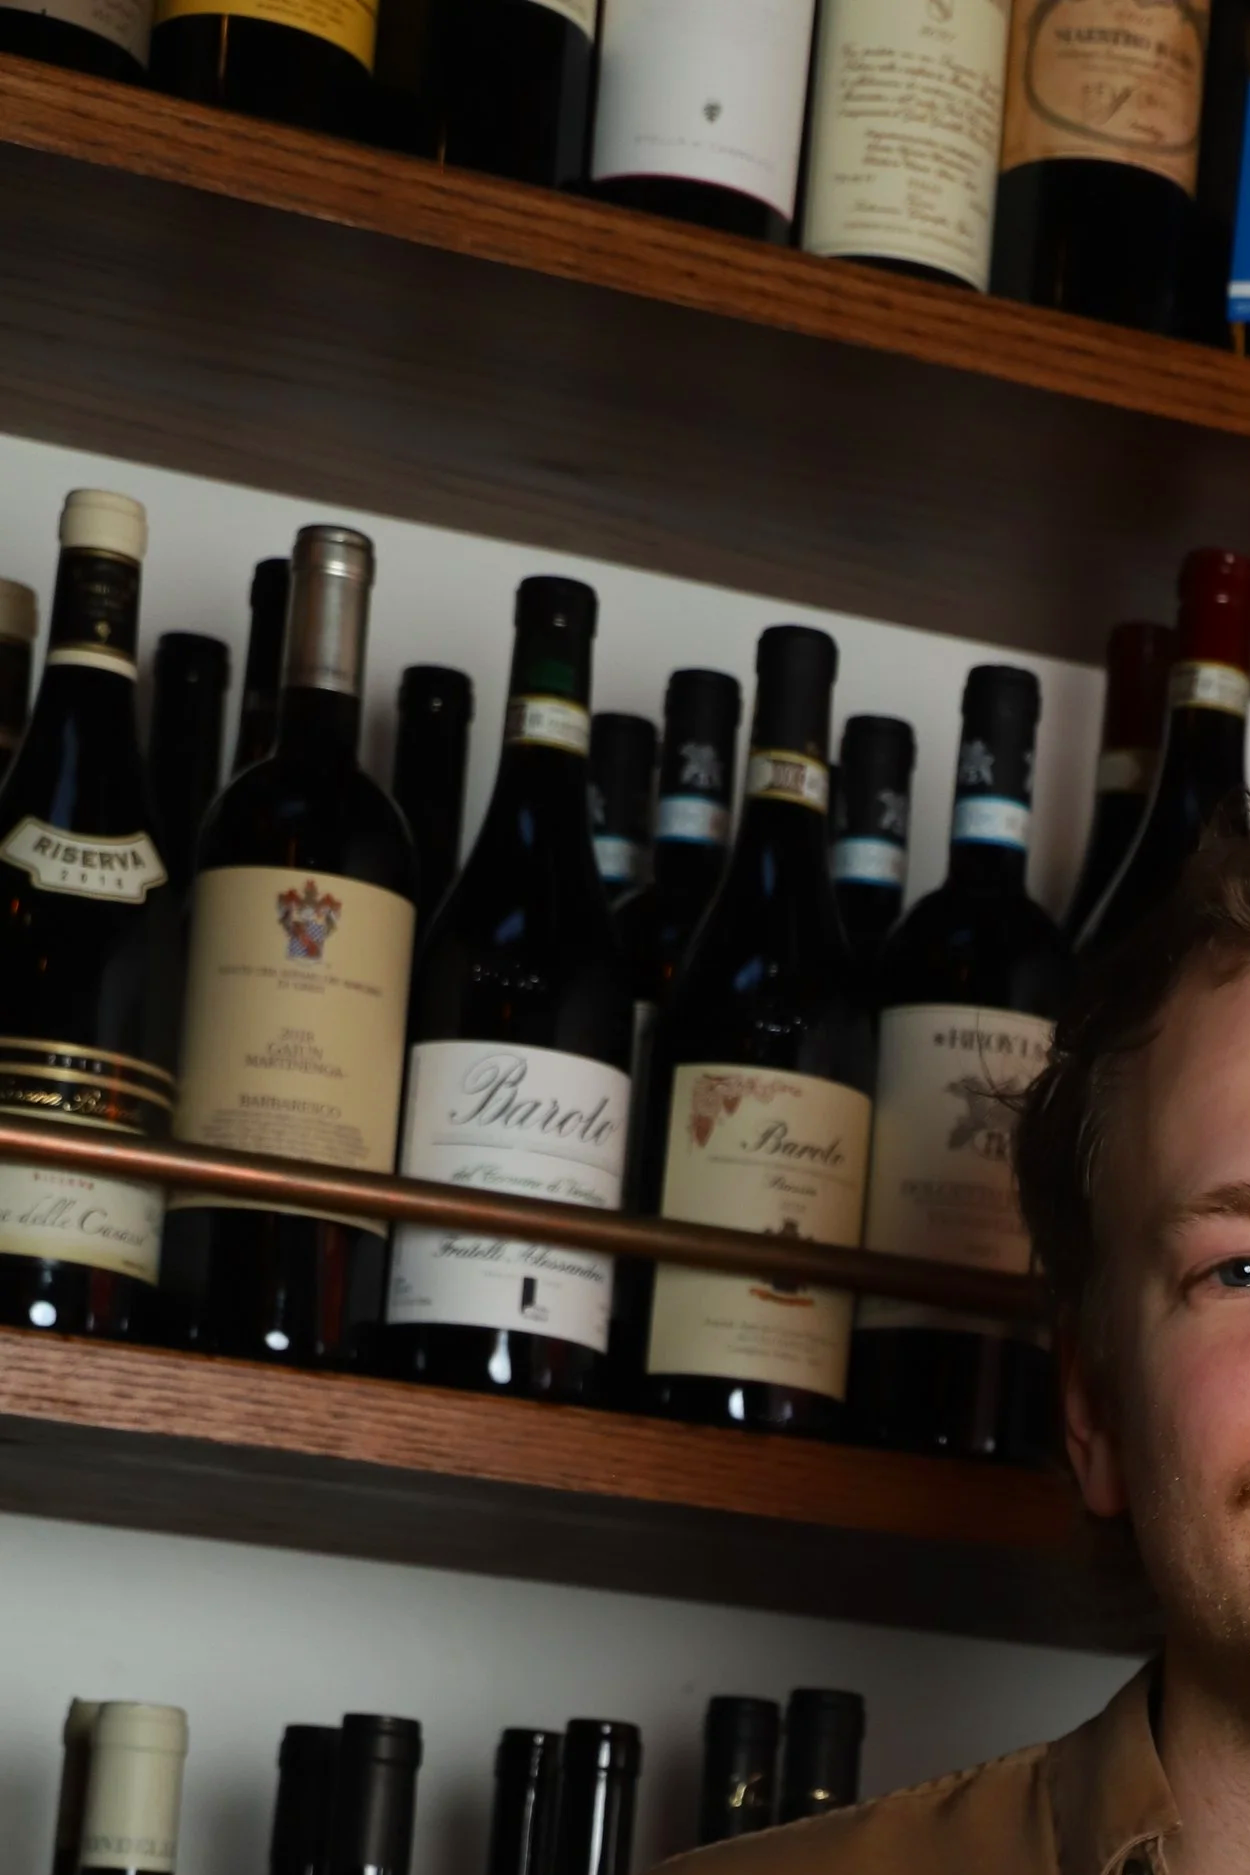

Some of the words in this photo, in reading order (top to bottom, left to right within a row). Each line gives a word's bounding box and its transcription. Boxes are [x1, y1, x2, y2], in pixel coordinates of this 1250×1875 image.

[33, 836, 146, 872] RISERVA
[449, 1052, 622, 1146] Barolo
[741, 1120, 846, 1167] Barolo
